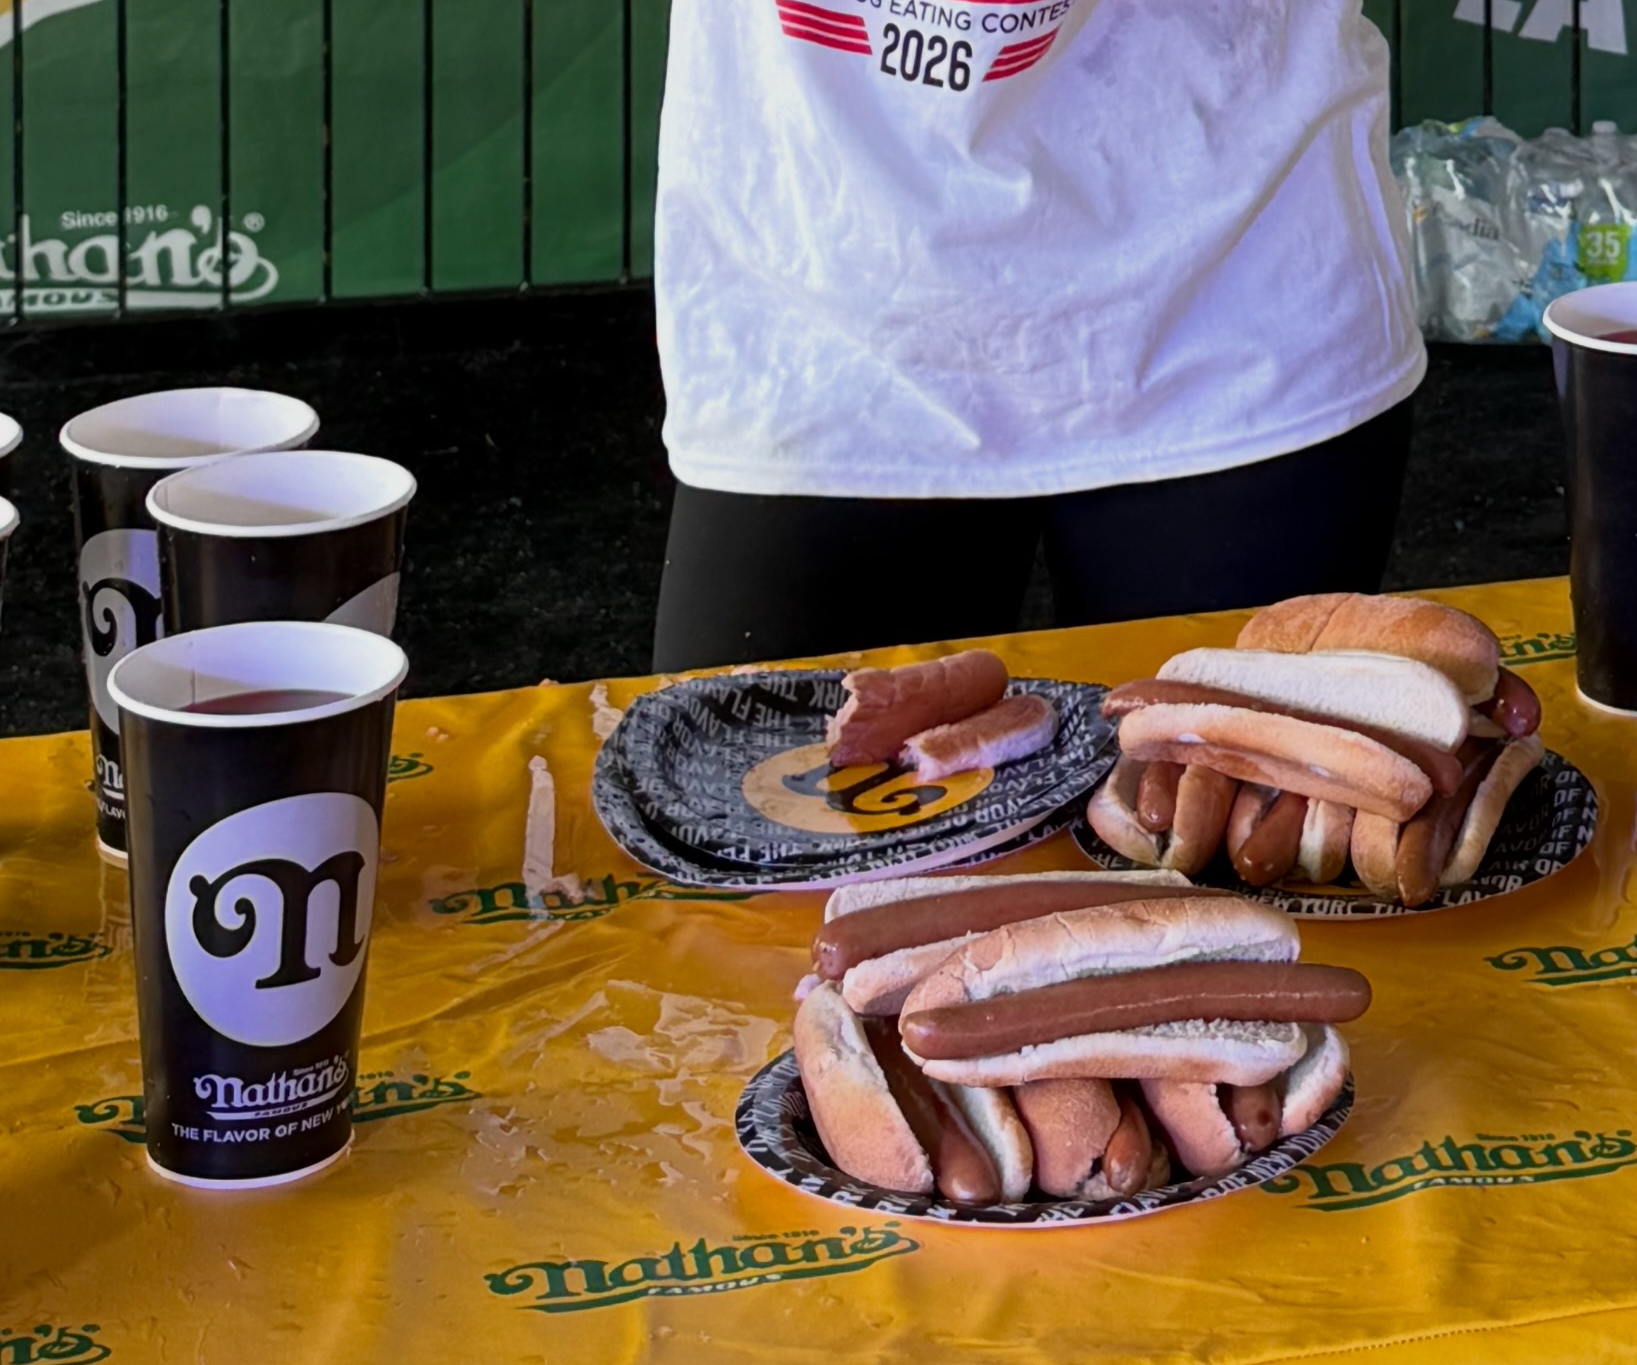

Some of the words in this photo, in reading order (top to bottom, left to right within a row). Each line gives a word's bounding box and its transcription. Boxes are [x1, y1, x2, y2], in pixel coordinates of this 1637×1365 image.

[879, 22, 974, 93] 2026
[61, 211, 117, 229] Since
[1586, 231, 1621, 259] 35
[193, 1055, 349, 1109] Nathan's
[172, 1122, 200, 1141] THE
[203, 1126, 271, 1144] FLAVOR
[275, 1122, 299, 1138] OF
[300, 1111, 334, 1133] NEW
[483, 1226, 902, 1301] Nathan's
[648, 1273, 783, 1296] FAMOUS
